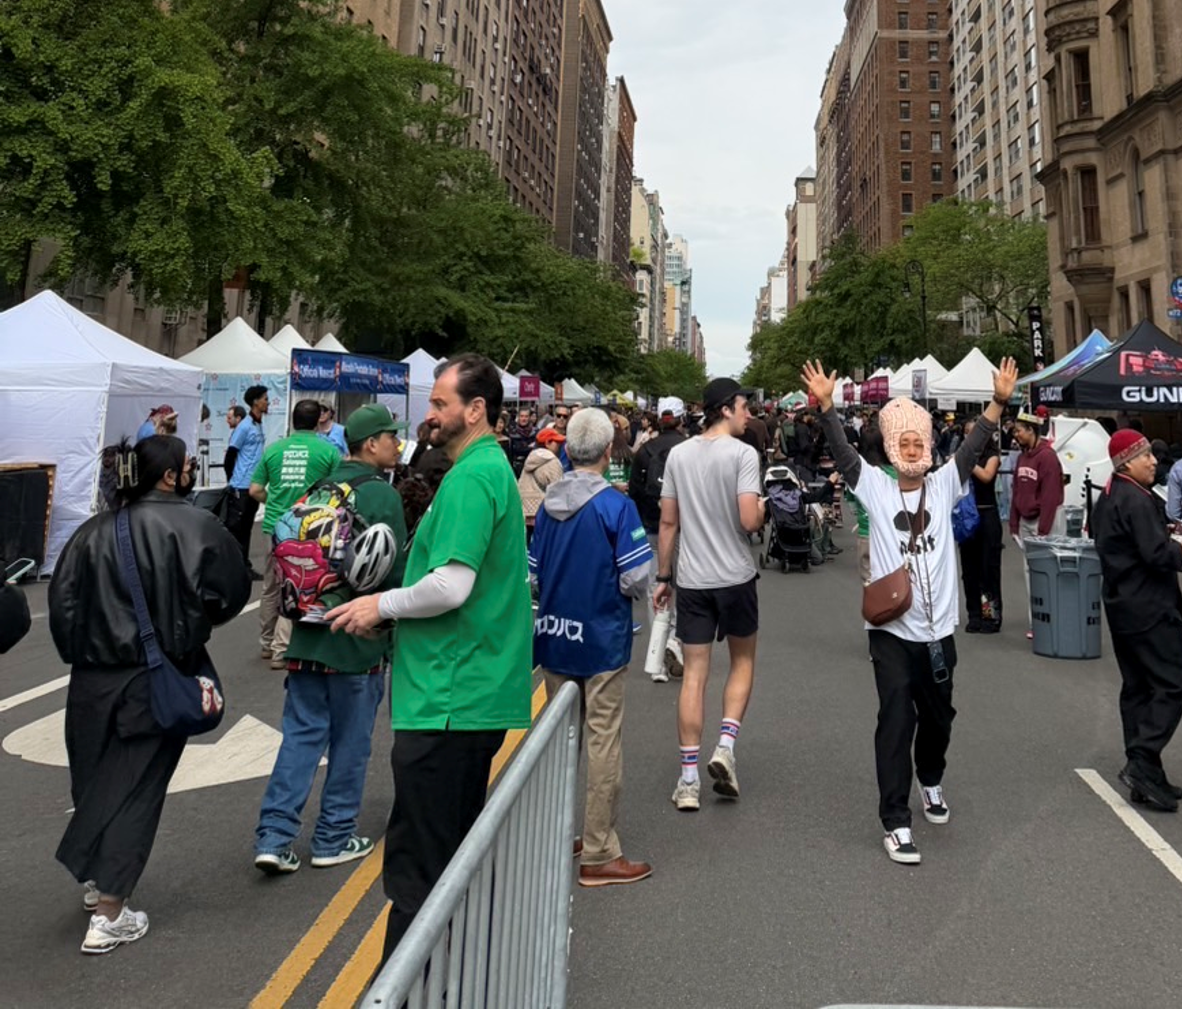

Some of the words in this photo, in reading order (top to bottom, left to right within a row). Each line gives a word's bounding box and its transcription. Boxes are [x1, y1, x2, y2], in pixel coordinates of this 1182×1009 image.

[1032, 321, 1044, 357] PARK
[534, 615, 584, 644] ロンパス
